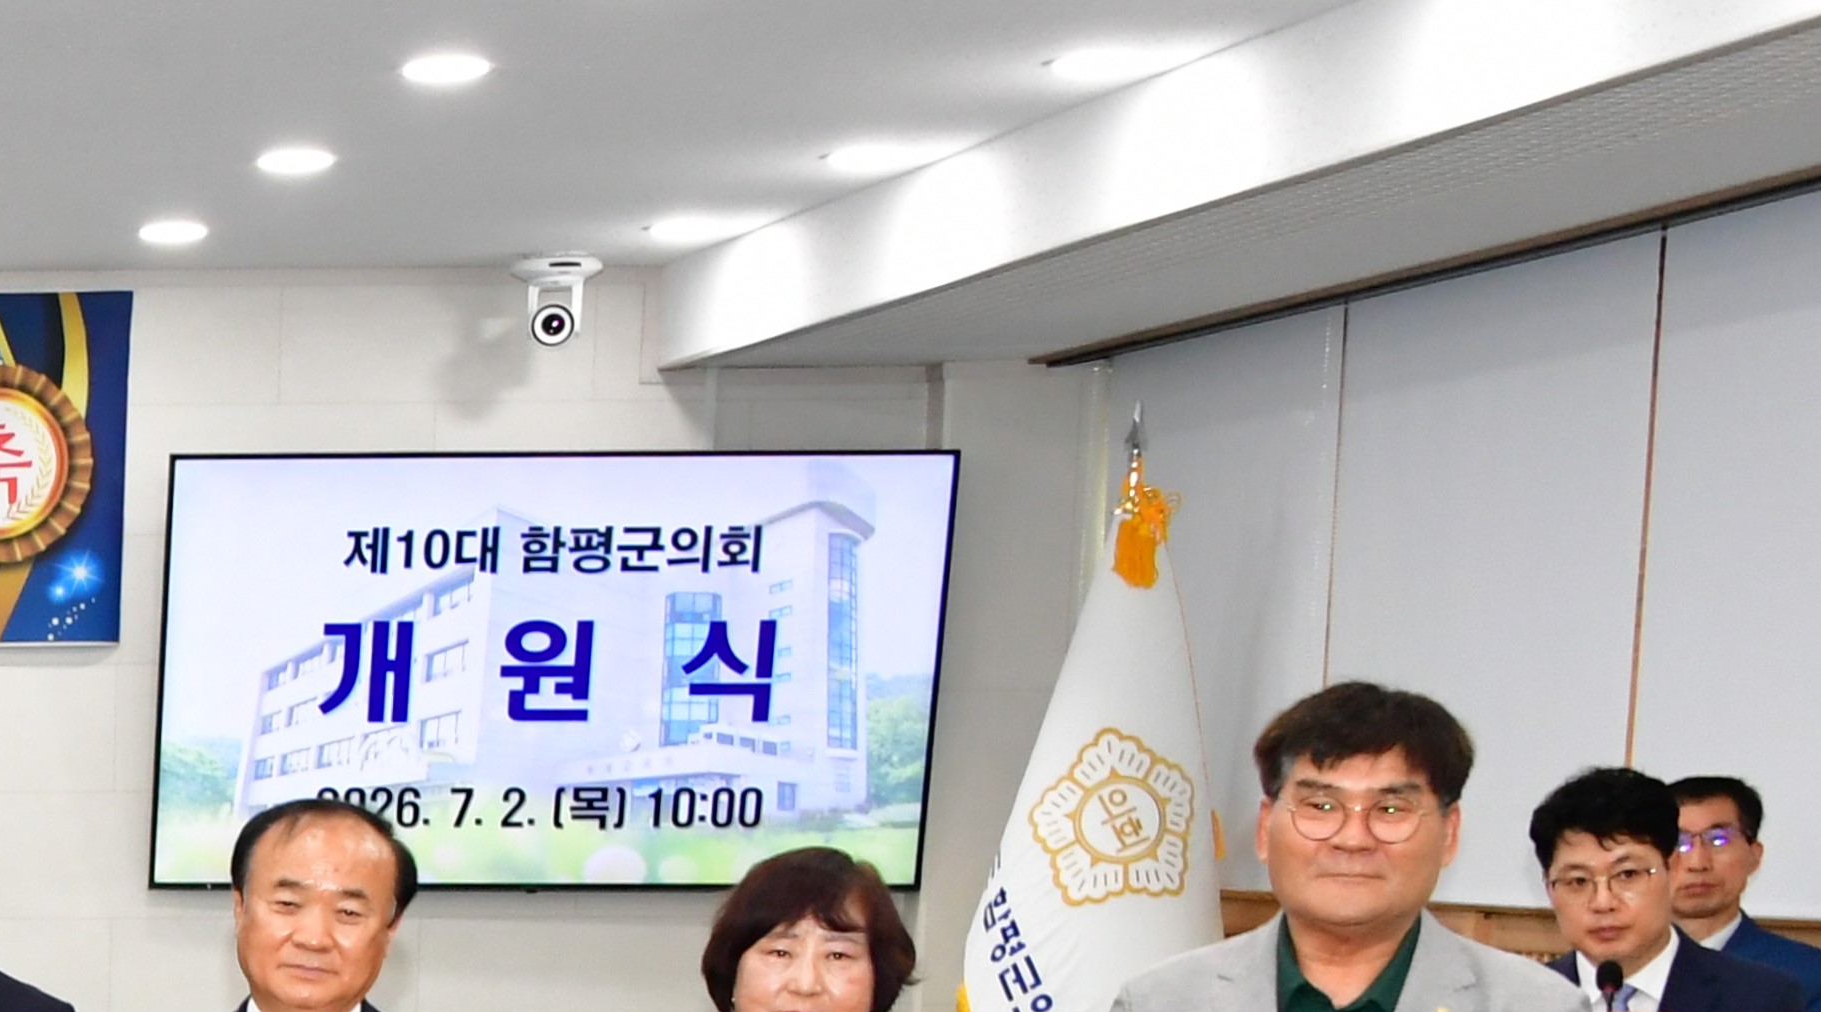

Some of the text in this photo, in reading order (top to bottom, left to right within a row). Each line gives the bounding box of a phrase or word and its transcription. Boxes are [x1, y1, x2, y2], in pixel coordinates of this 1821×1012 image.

[343, 524, 763, 575] 제10대 함평군의회
[319, 619, 777, 723] 개 원 식
[317, 788, 430, 827] 26.
[451, 788, 482, 827] 7.
[648, 787, 763, 828] 10:00
